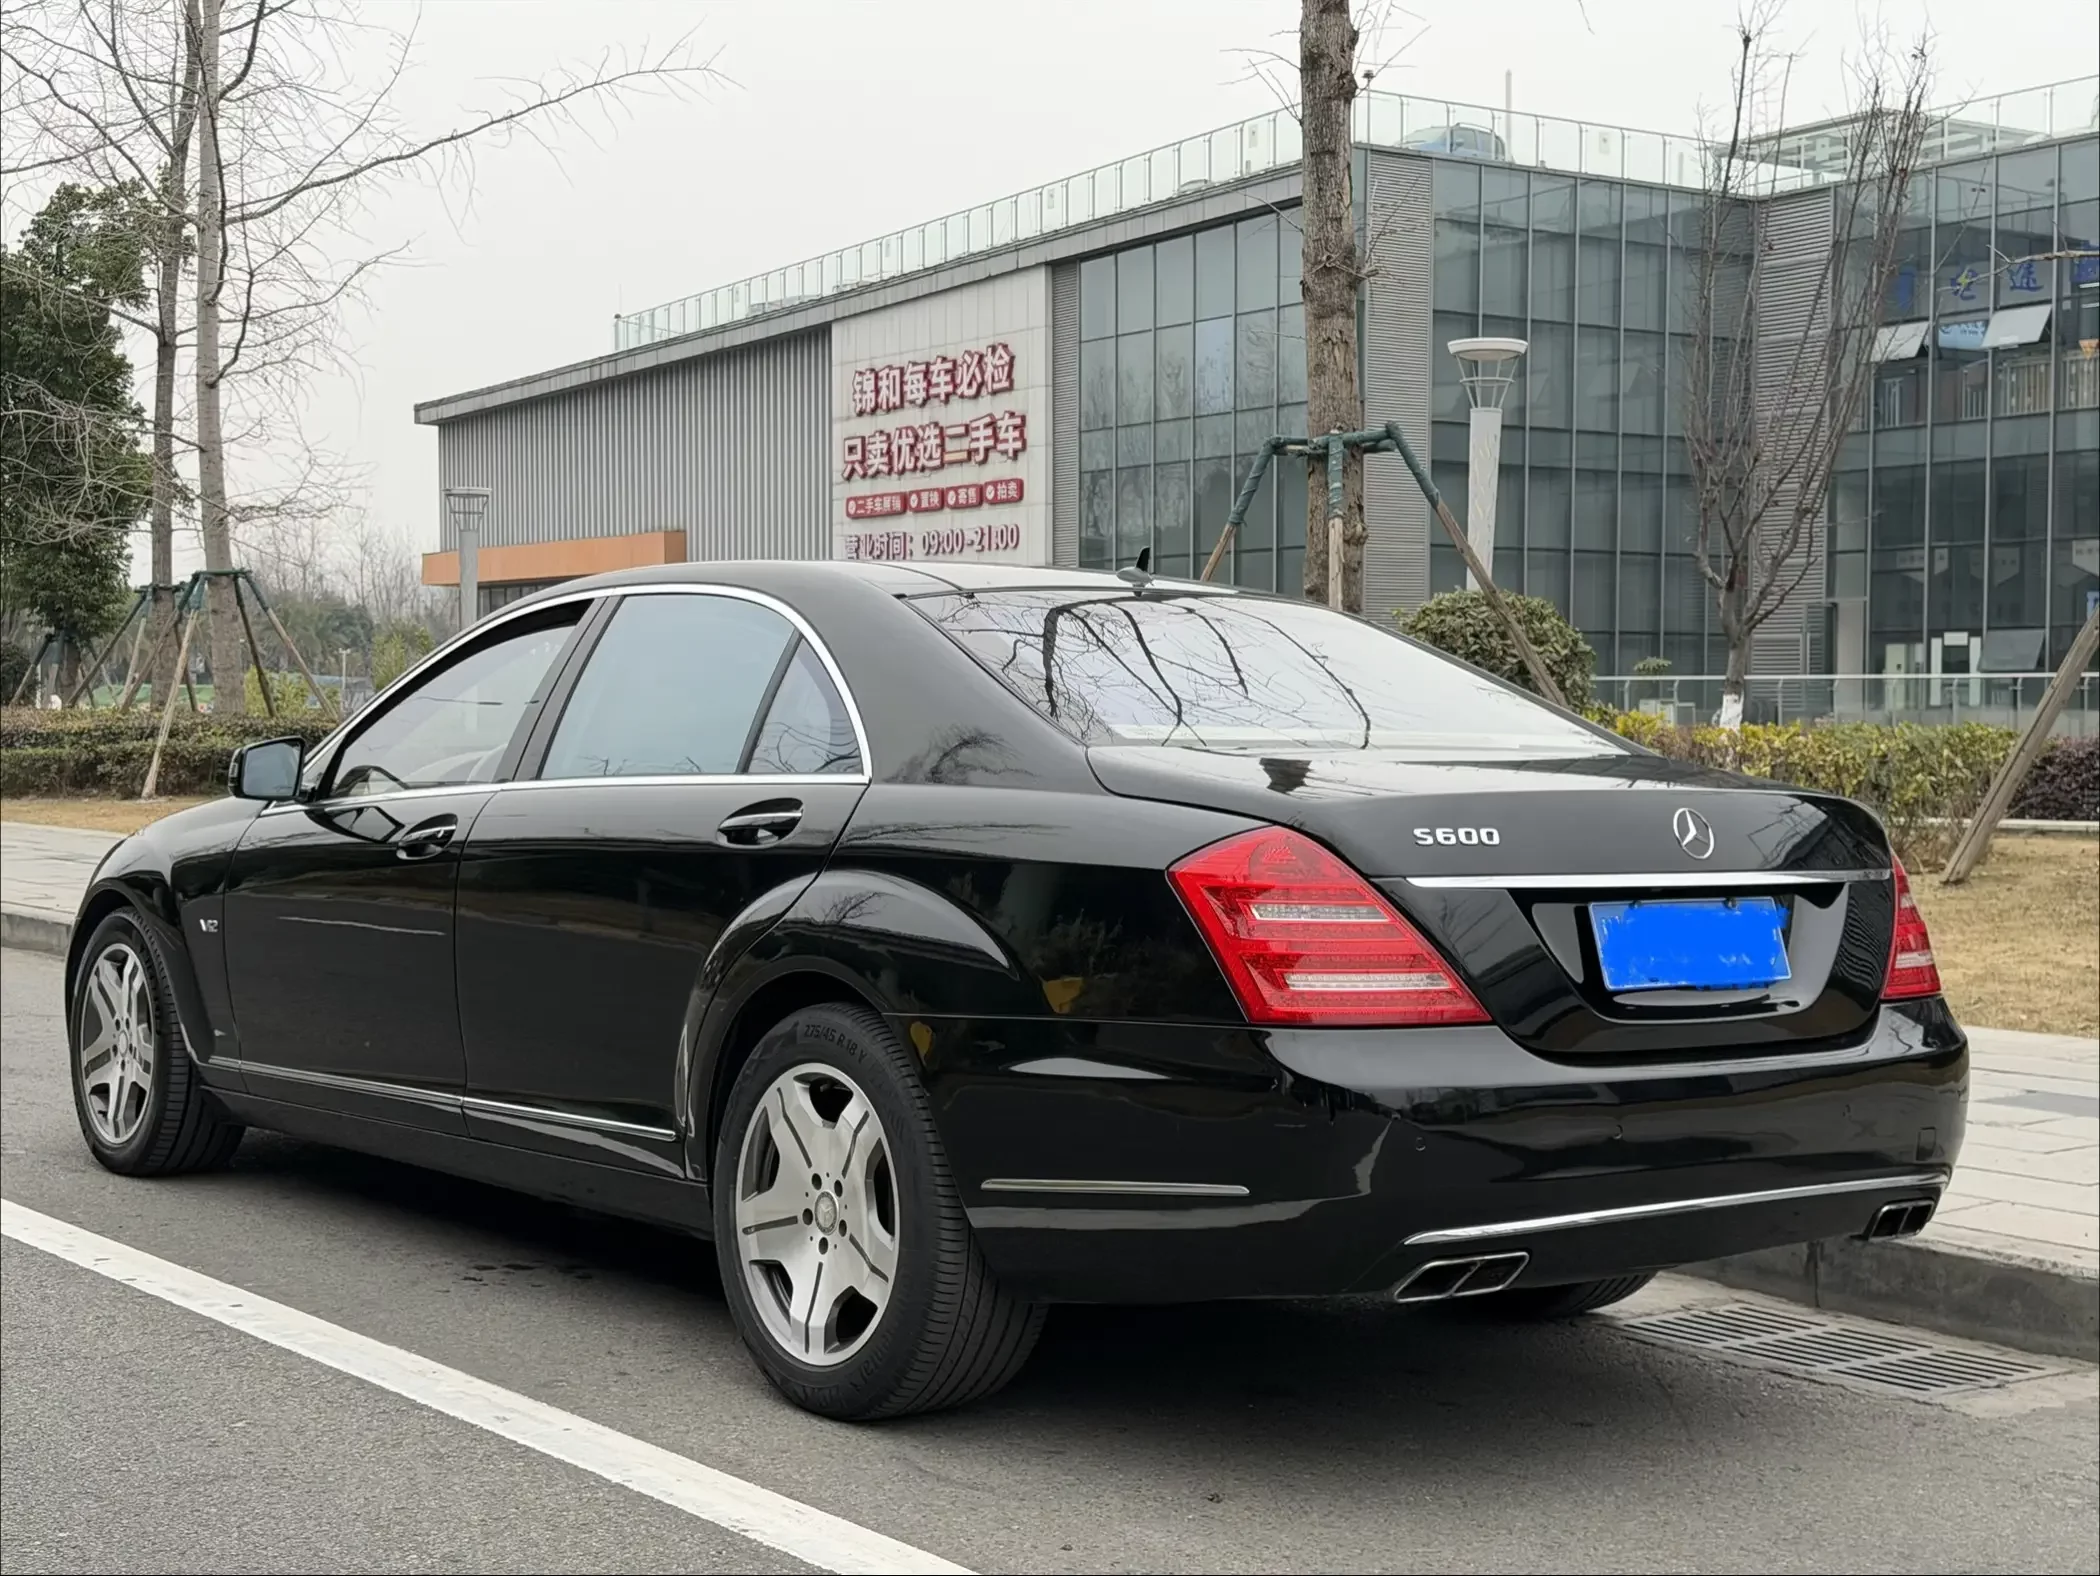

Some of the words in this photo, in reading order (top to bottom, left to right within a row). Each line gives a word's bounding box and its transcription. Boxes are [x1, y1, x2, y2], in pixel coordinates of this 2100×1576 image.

[852, 342, 1015, 416] 锦和每车必检
[842, 411, 1027, 481] 只卖优选二手车
[1413, 827, 1500, 847] S600
[804, 1024, 837, 1043] 275/45
